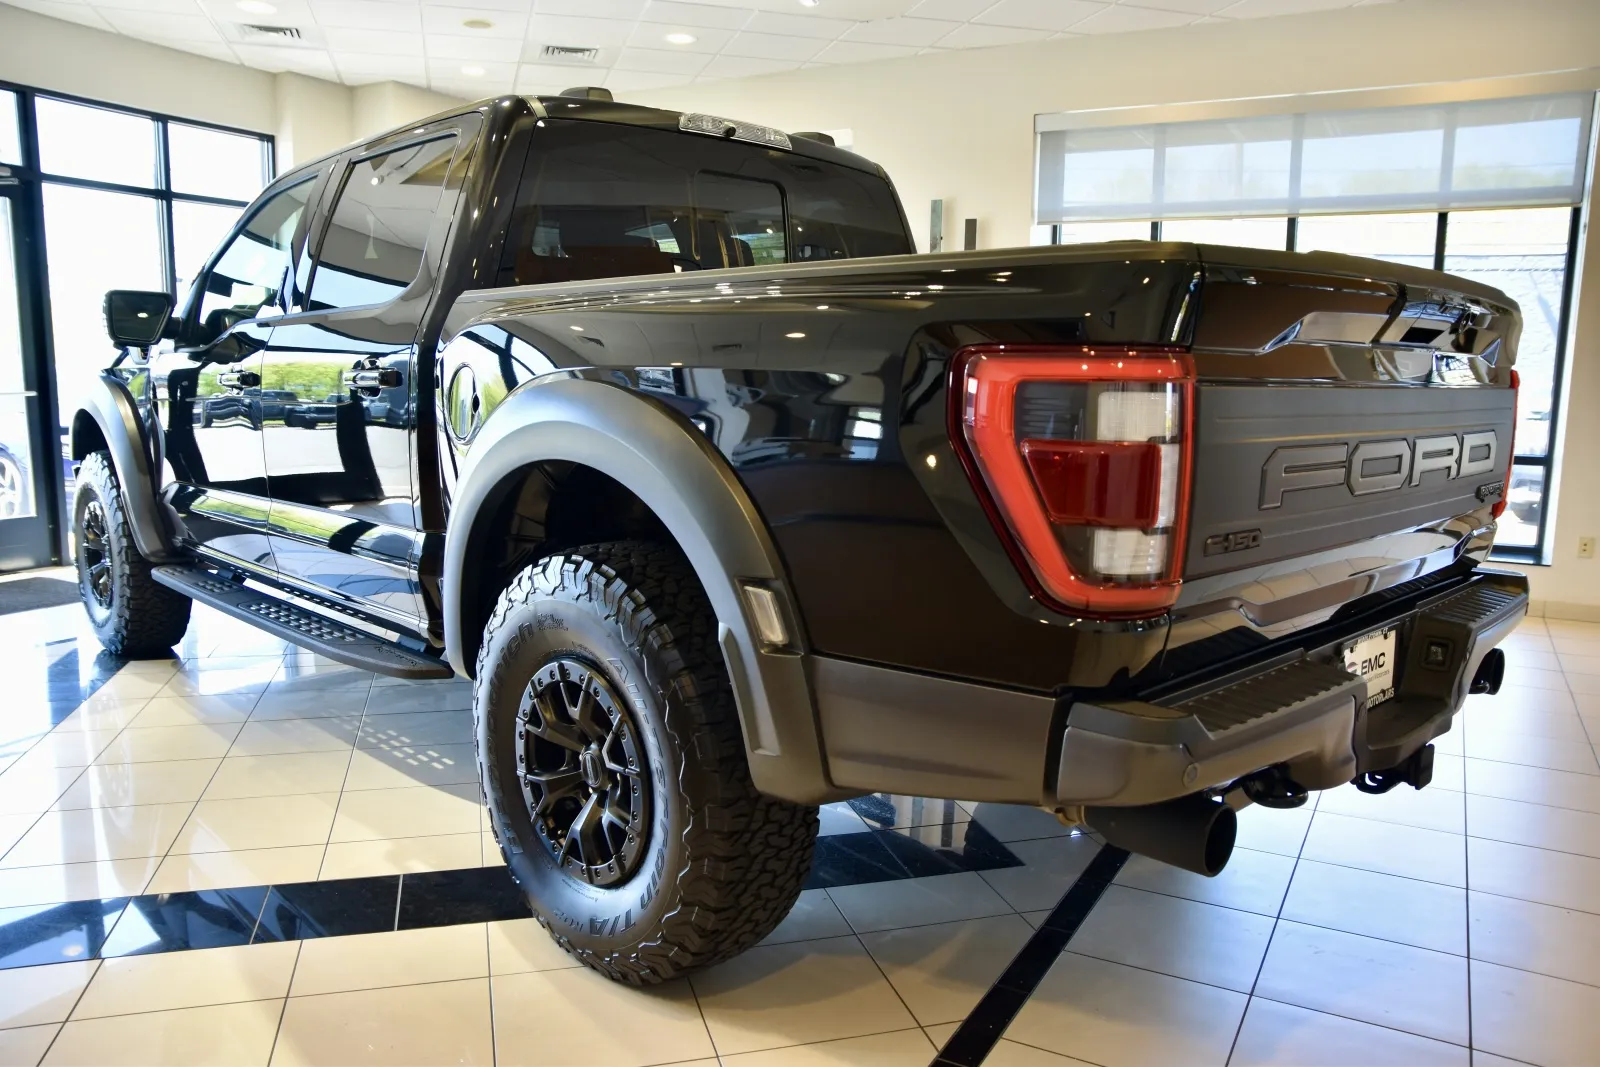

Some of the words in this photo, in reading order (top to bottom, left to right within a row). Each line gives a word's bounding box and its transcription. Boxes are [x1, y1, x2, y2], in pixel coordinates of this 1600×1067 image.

[1258, 429, 1497, 510] FORD
[1203, 528, 1262, 557] F-150
[1361, 652, 1385, 676] EMC
[589, 908, 636, 938] T/A
